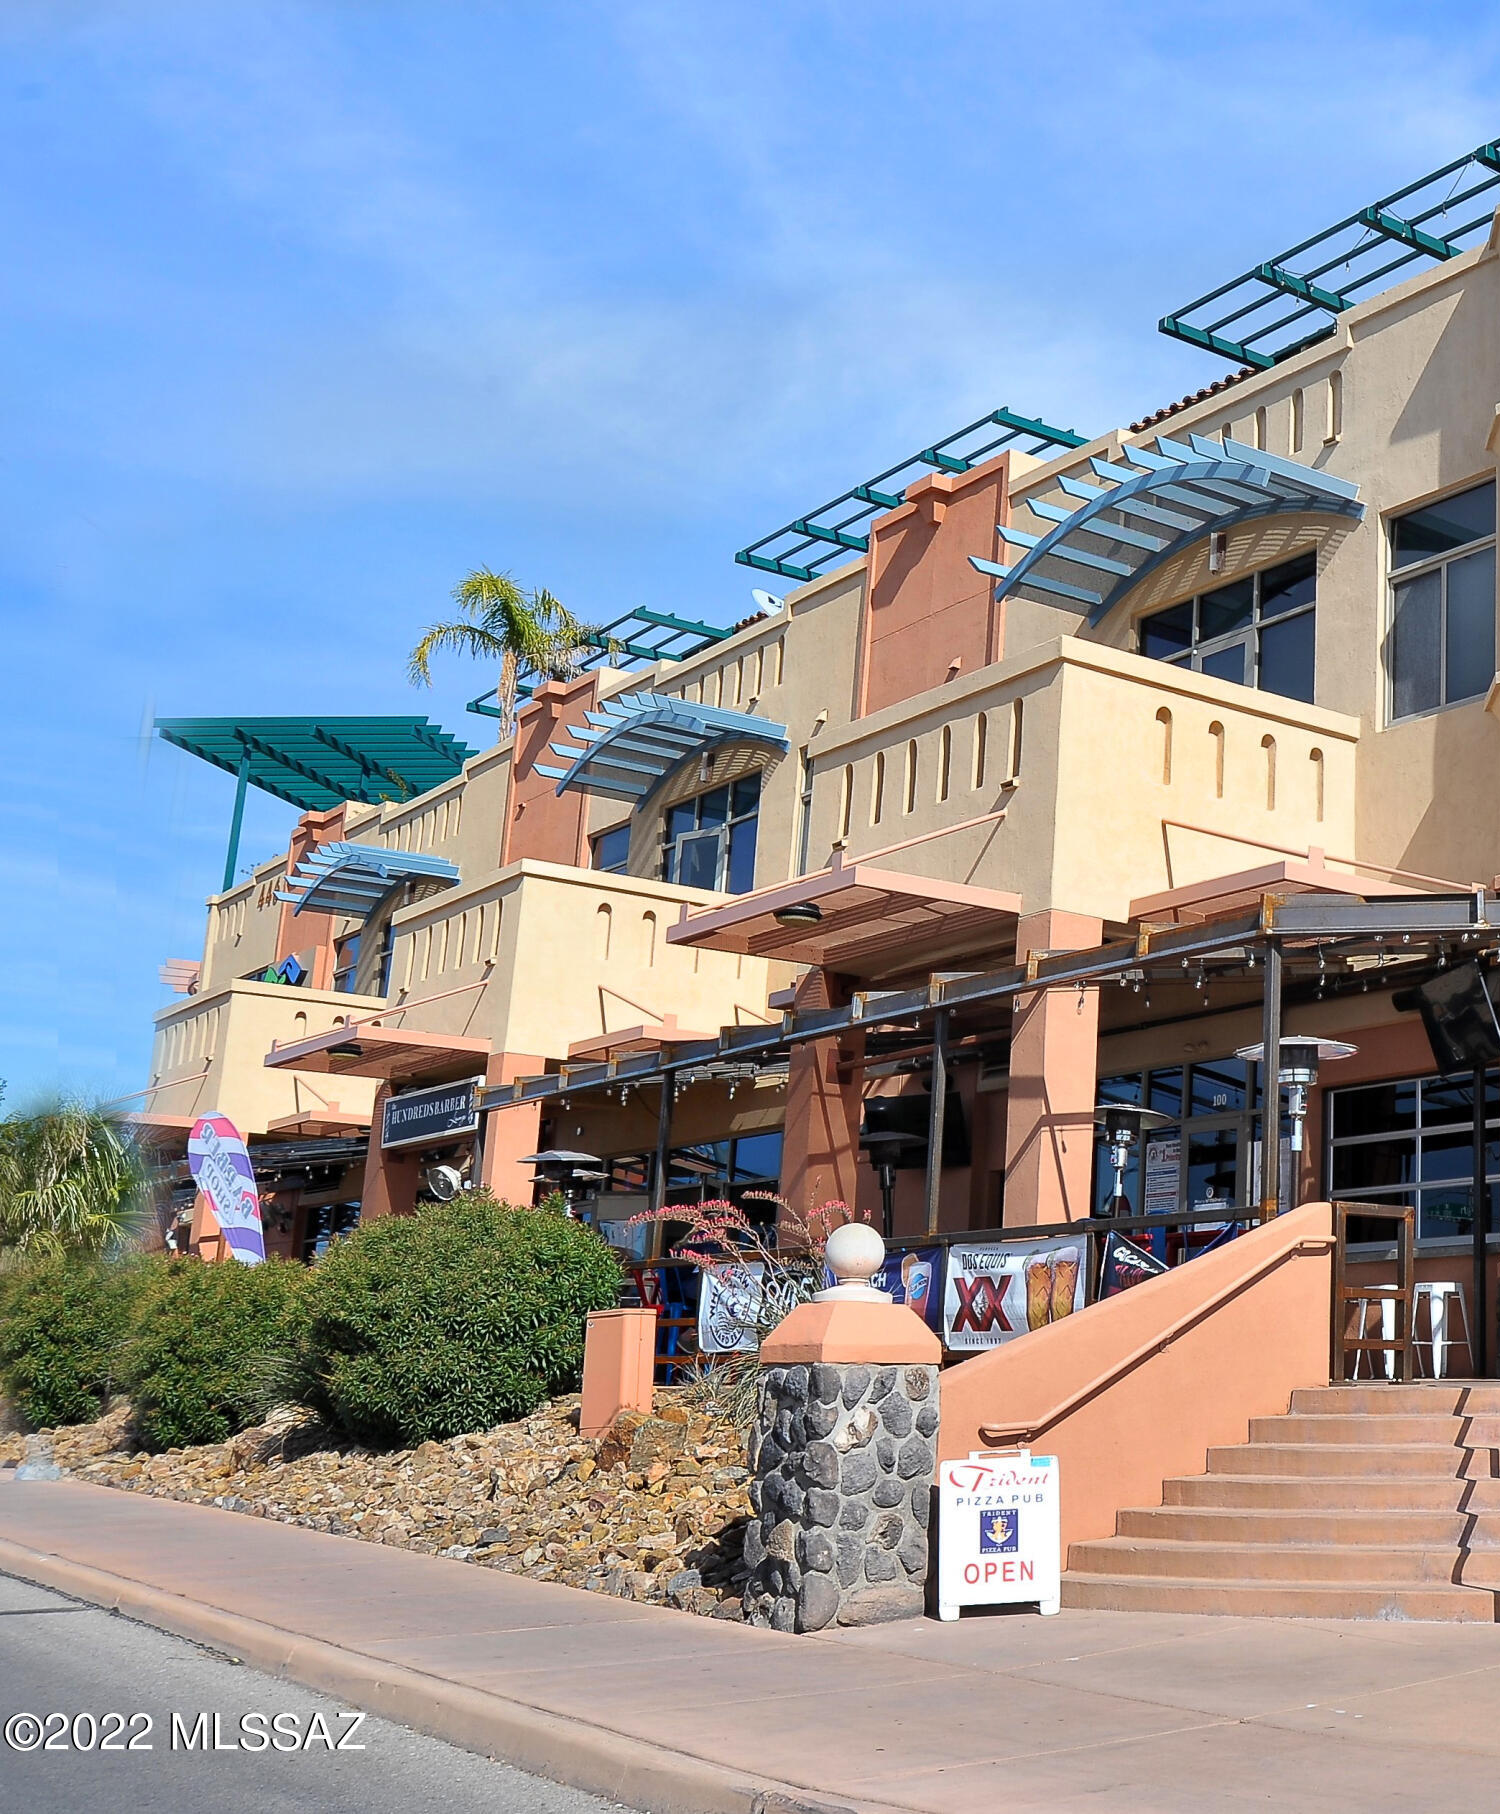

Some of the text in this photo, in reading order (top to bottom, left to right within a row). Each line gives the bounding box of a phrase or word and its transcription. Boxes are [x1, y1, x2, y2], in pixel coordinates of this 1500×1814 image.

[1212, 1093, 1227, 1107] 100
[961, 1252, 1010, 1270] DOS EQUIS
[951, 1274, 1014, 1333] XX
[949, 1465, 1049, 1492] Trident
[956, 1493, 1044, 1507] PIZZA PUB
[964, 1560, 1034, 1585] OPEN
